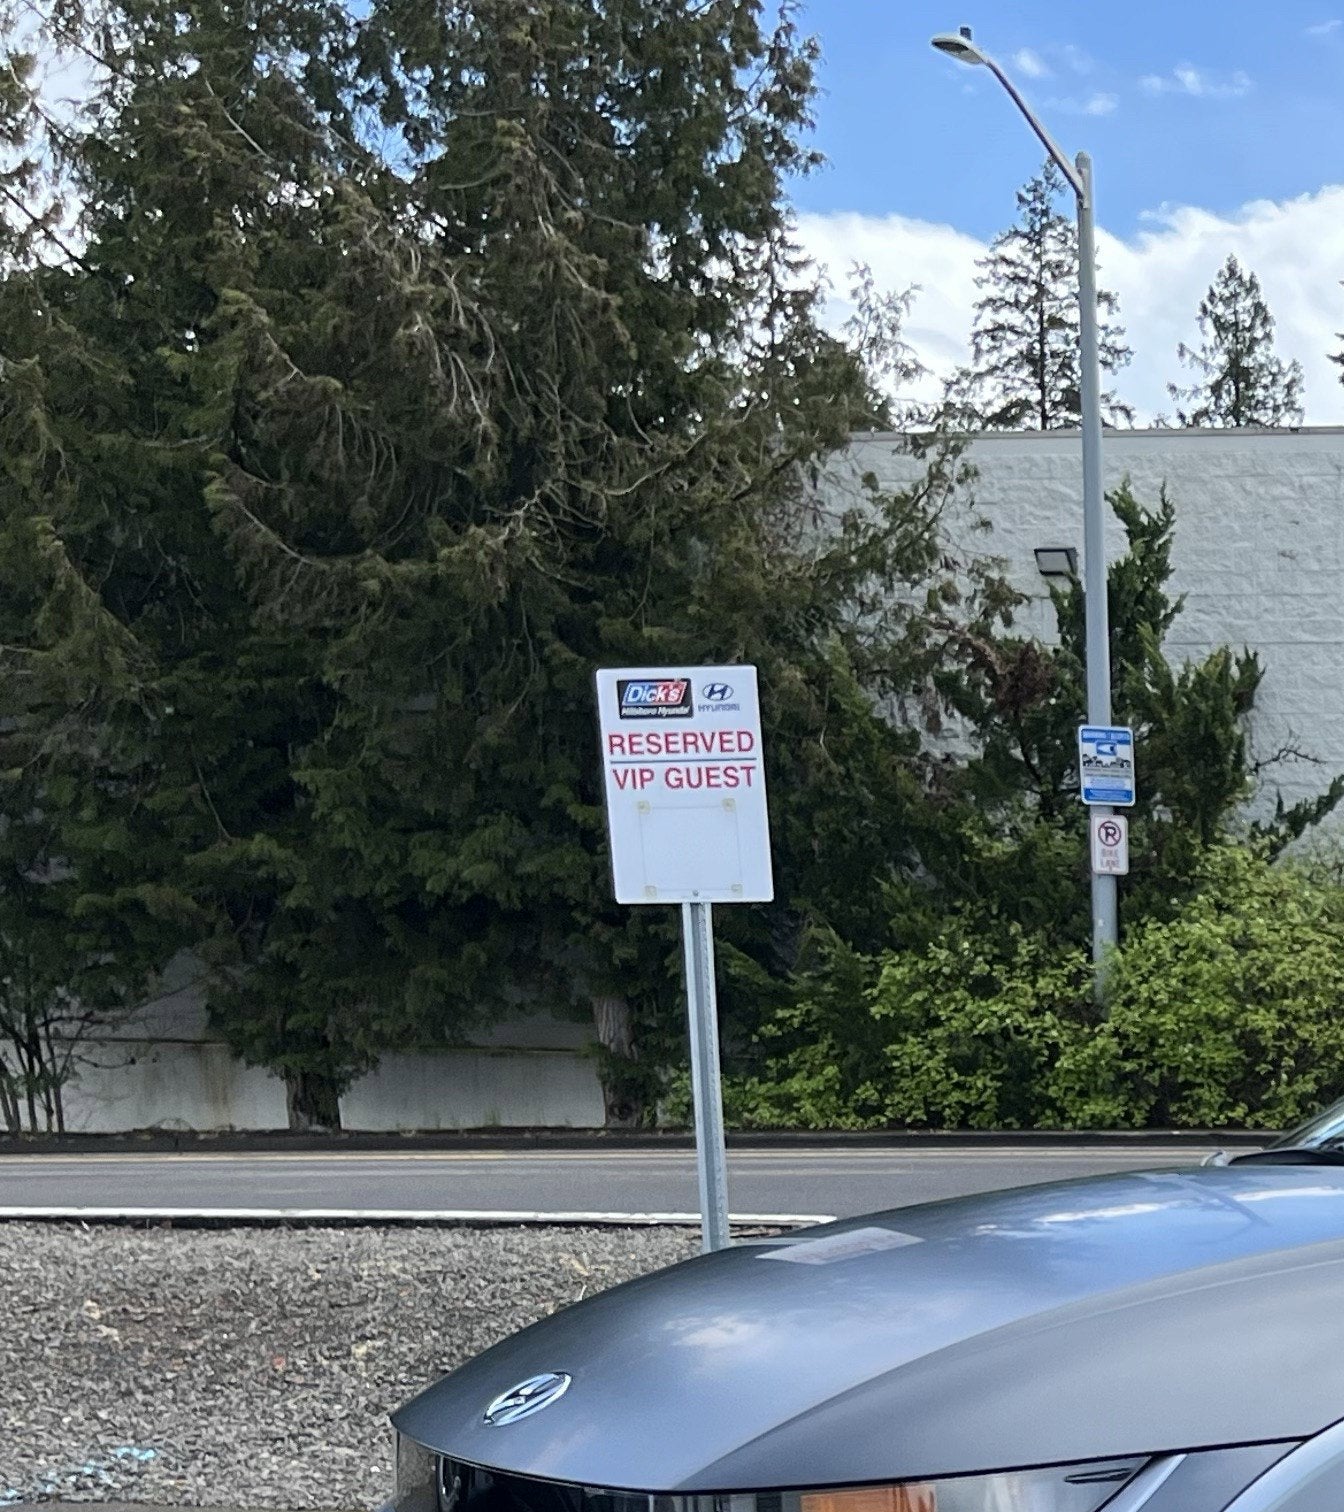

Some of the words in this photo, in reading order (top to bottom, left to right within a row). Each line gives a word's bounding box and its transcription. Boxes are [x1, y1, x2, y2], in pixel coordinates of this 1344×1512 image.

[608, 731, 754, 756] RESERVED
[613, 768, 655, 790] VIP
[665, 766, 756, 789] GUEST
